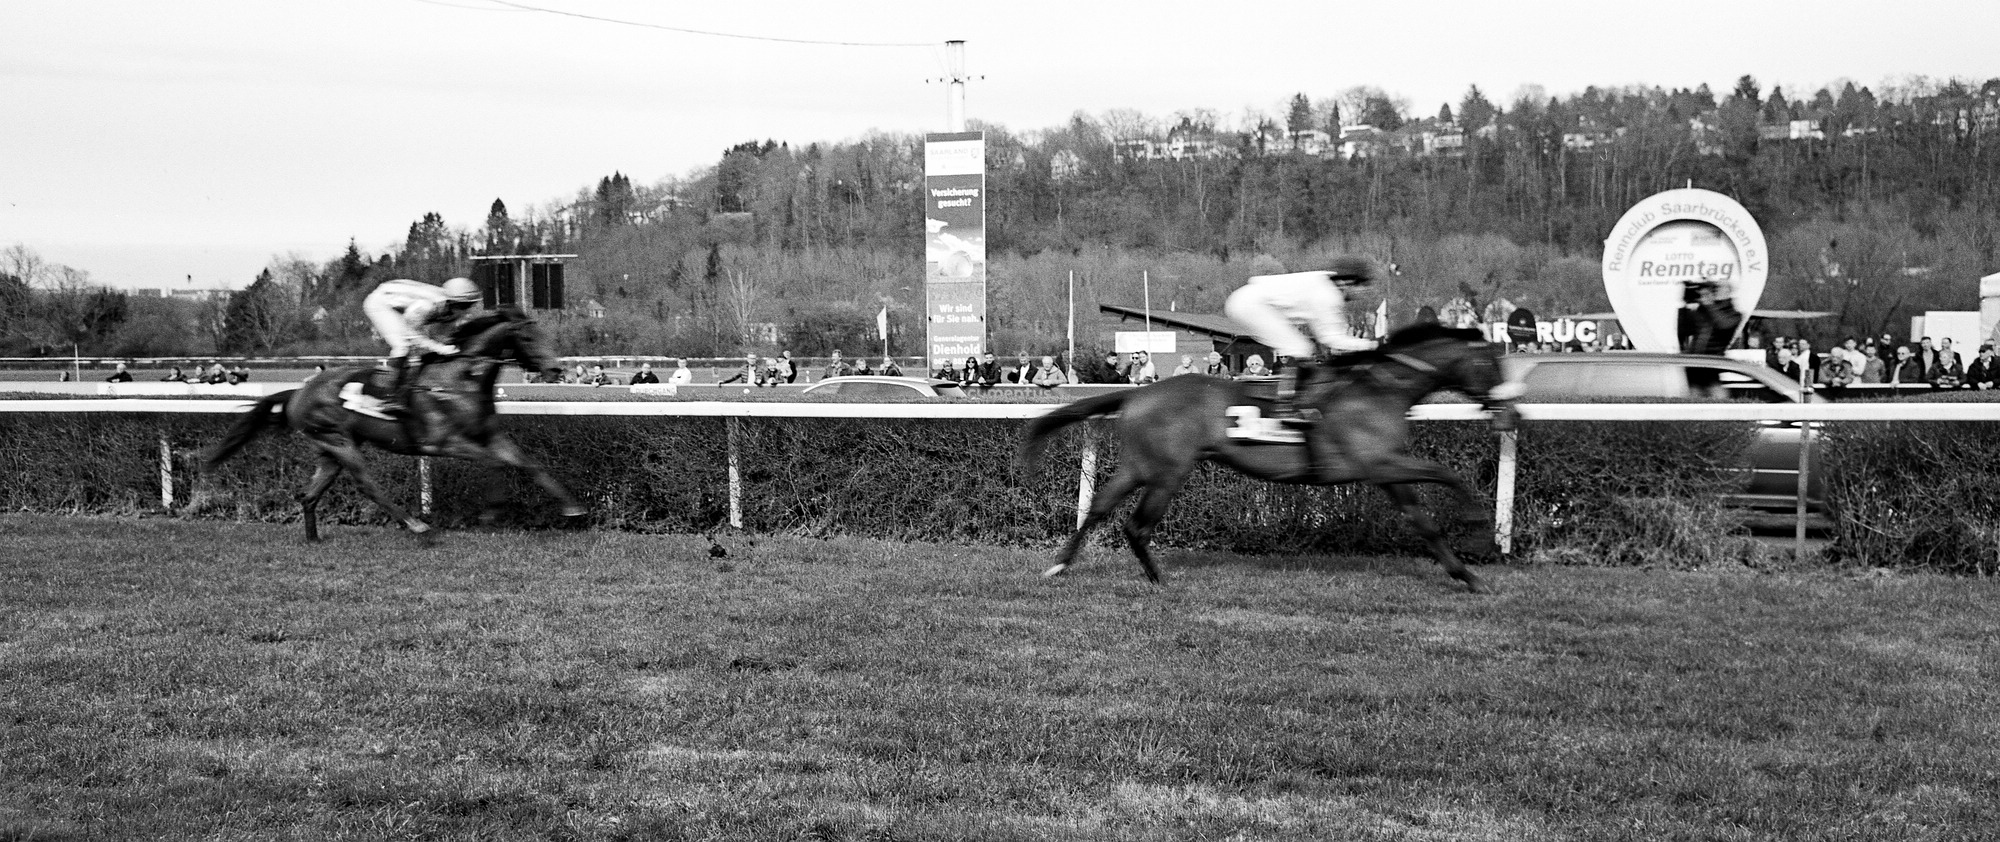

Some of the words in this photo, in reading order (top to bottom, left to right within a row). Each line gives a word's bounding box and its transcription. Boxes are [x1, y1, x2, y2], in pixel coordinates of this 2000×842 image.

[930, 187, 979, 197] Versicherung
[938, 197, 972, 209] gesucht?
[1608, 211, 1656, 272] Rennclub
[1660, 202, 1752, 248] Saarbrücken
[1665, 252, 1695, 261] LOTTO
[1639, 260, 1734, 280] Renntag
[939, 304, 953, 313] Wir
[955, 303, 973, 313] sind
[933, 314, 945, 323] für
[946, 314, 960, 323] Sie
[961, 314, 980, 323] nah.
[933, 343, 980, 355] Dienhold
[967, 387, 1052, 399] cumentus
